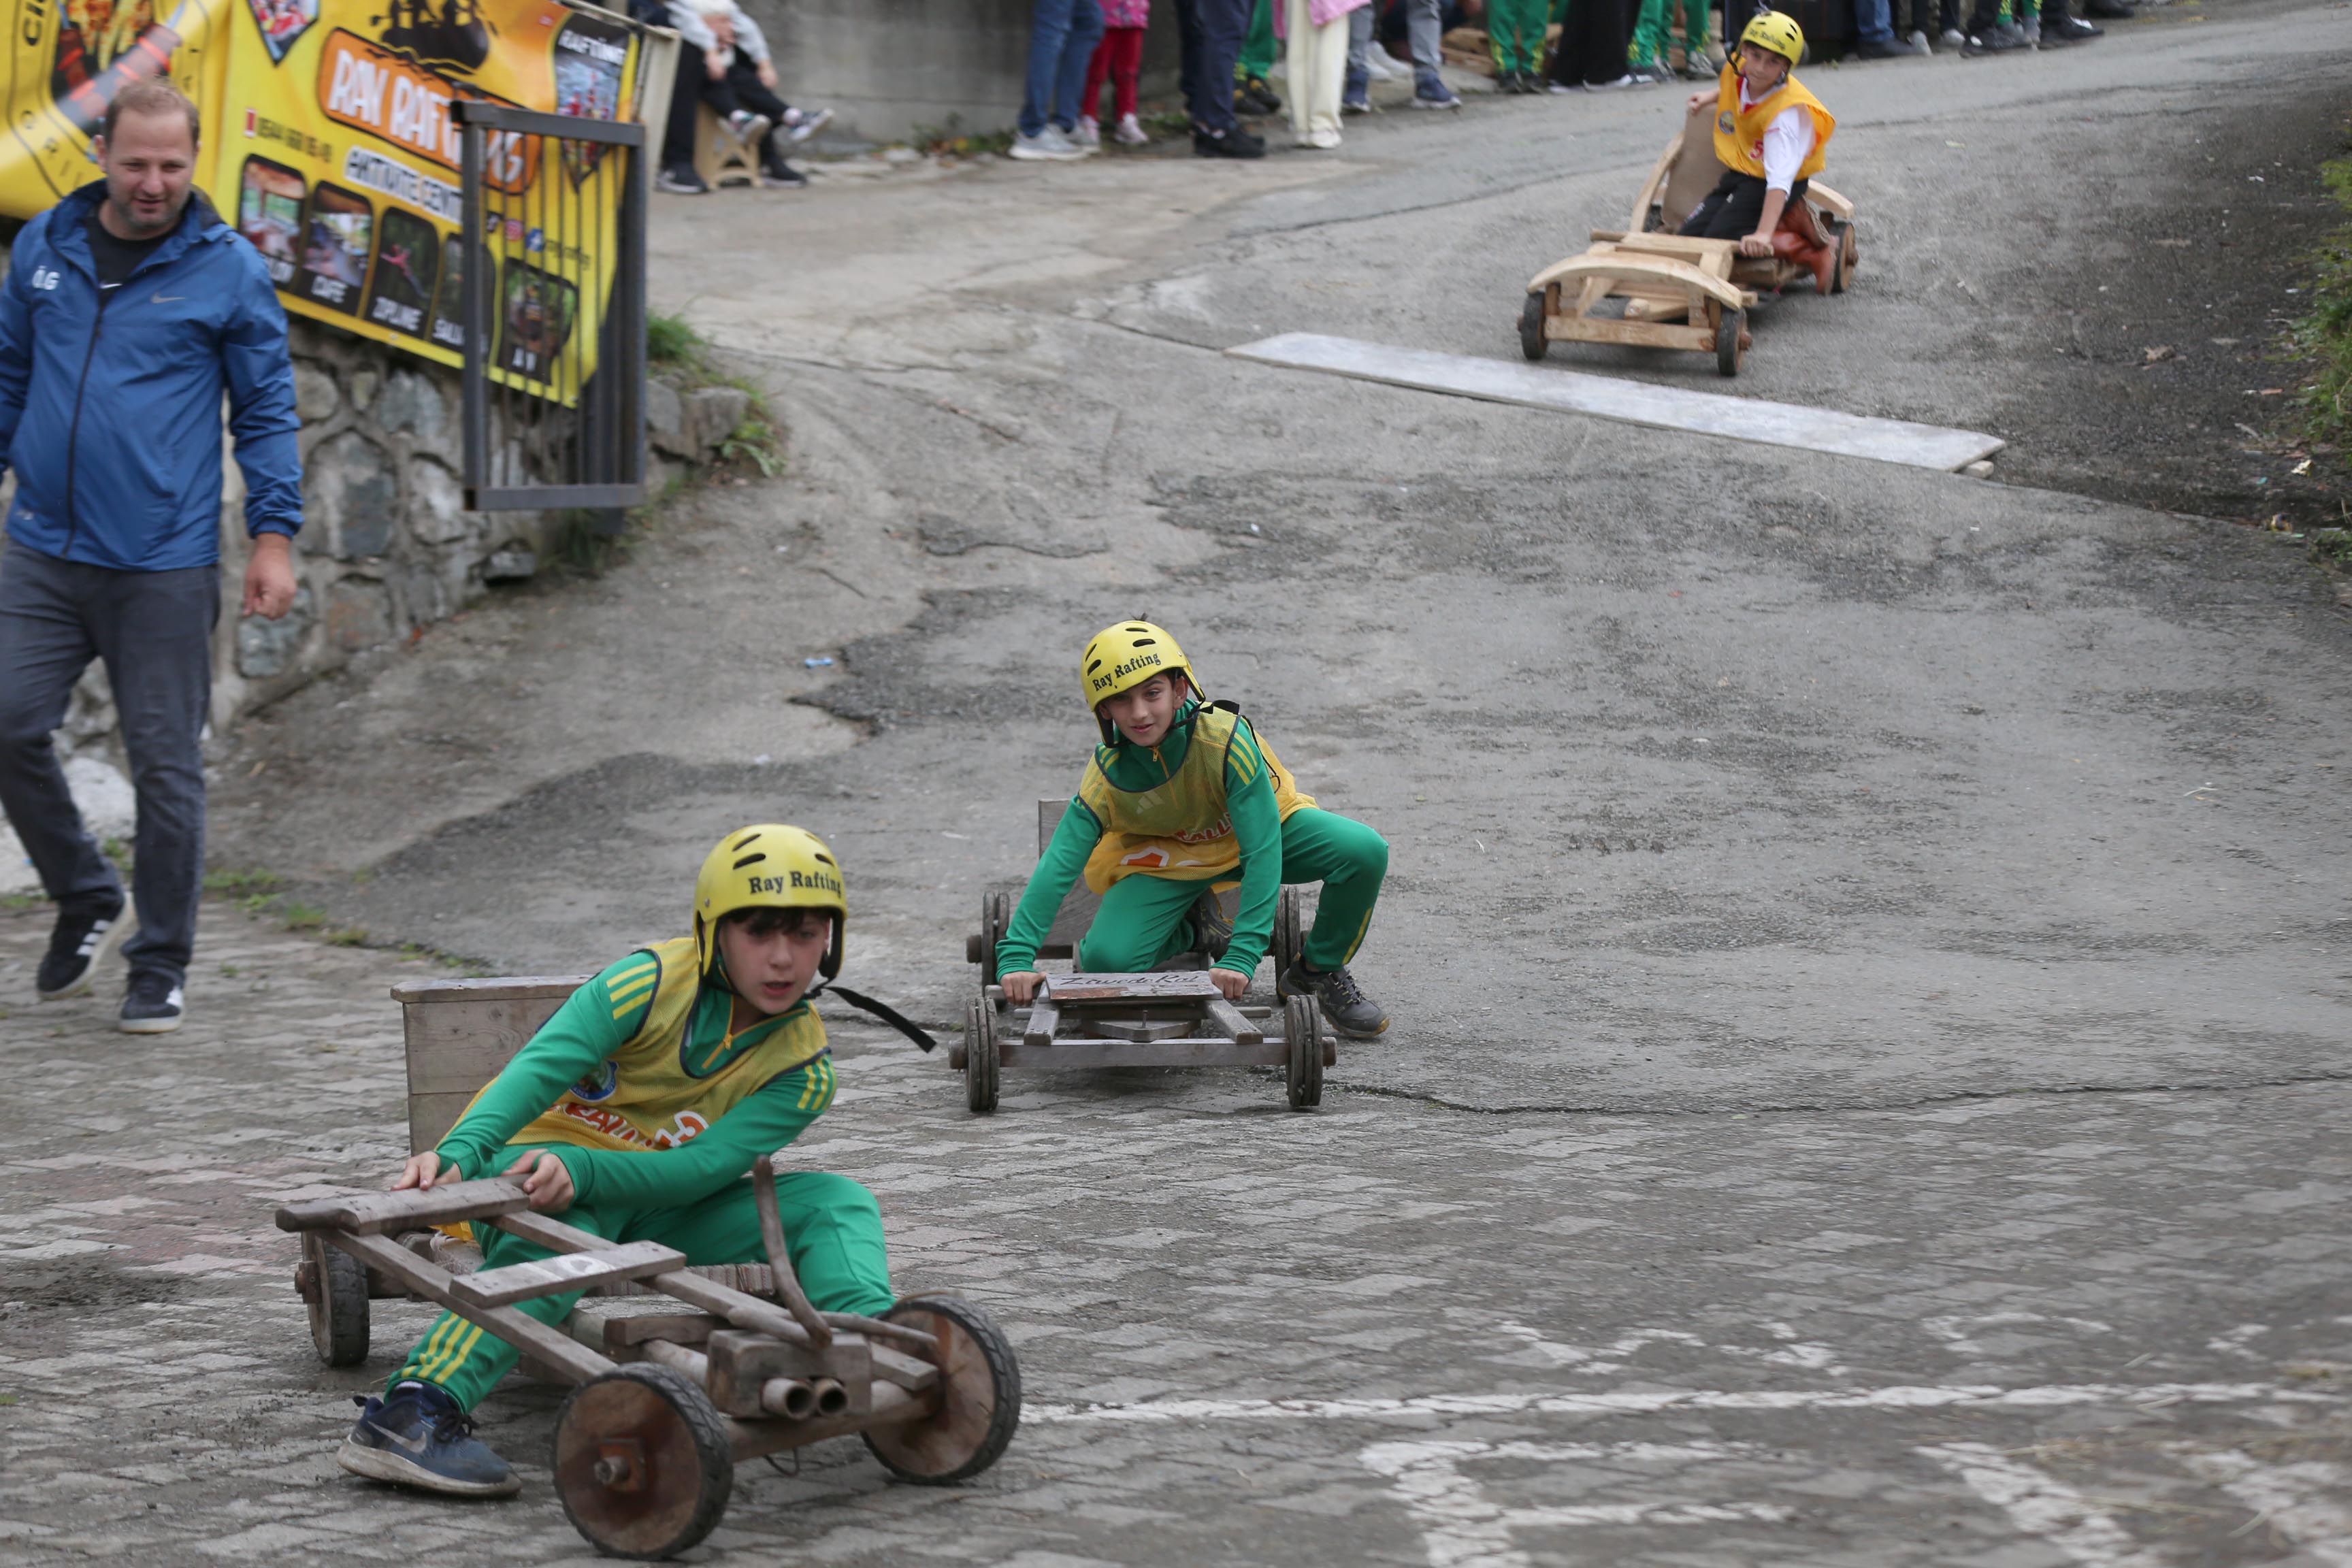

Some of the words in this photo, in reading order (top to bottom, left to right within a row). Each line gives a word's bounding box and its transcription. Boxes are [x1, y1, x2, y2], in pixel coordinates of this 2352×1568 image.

[327, 49, 389, 127] RAY
[1092, 672, 1113, 692] Ray
[1115, 653, 1161, 679] Rafting
[749, 875, 784, 896] Ray
[789, 870, 842, 899] Rafting
